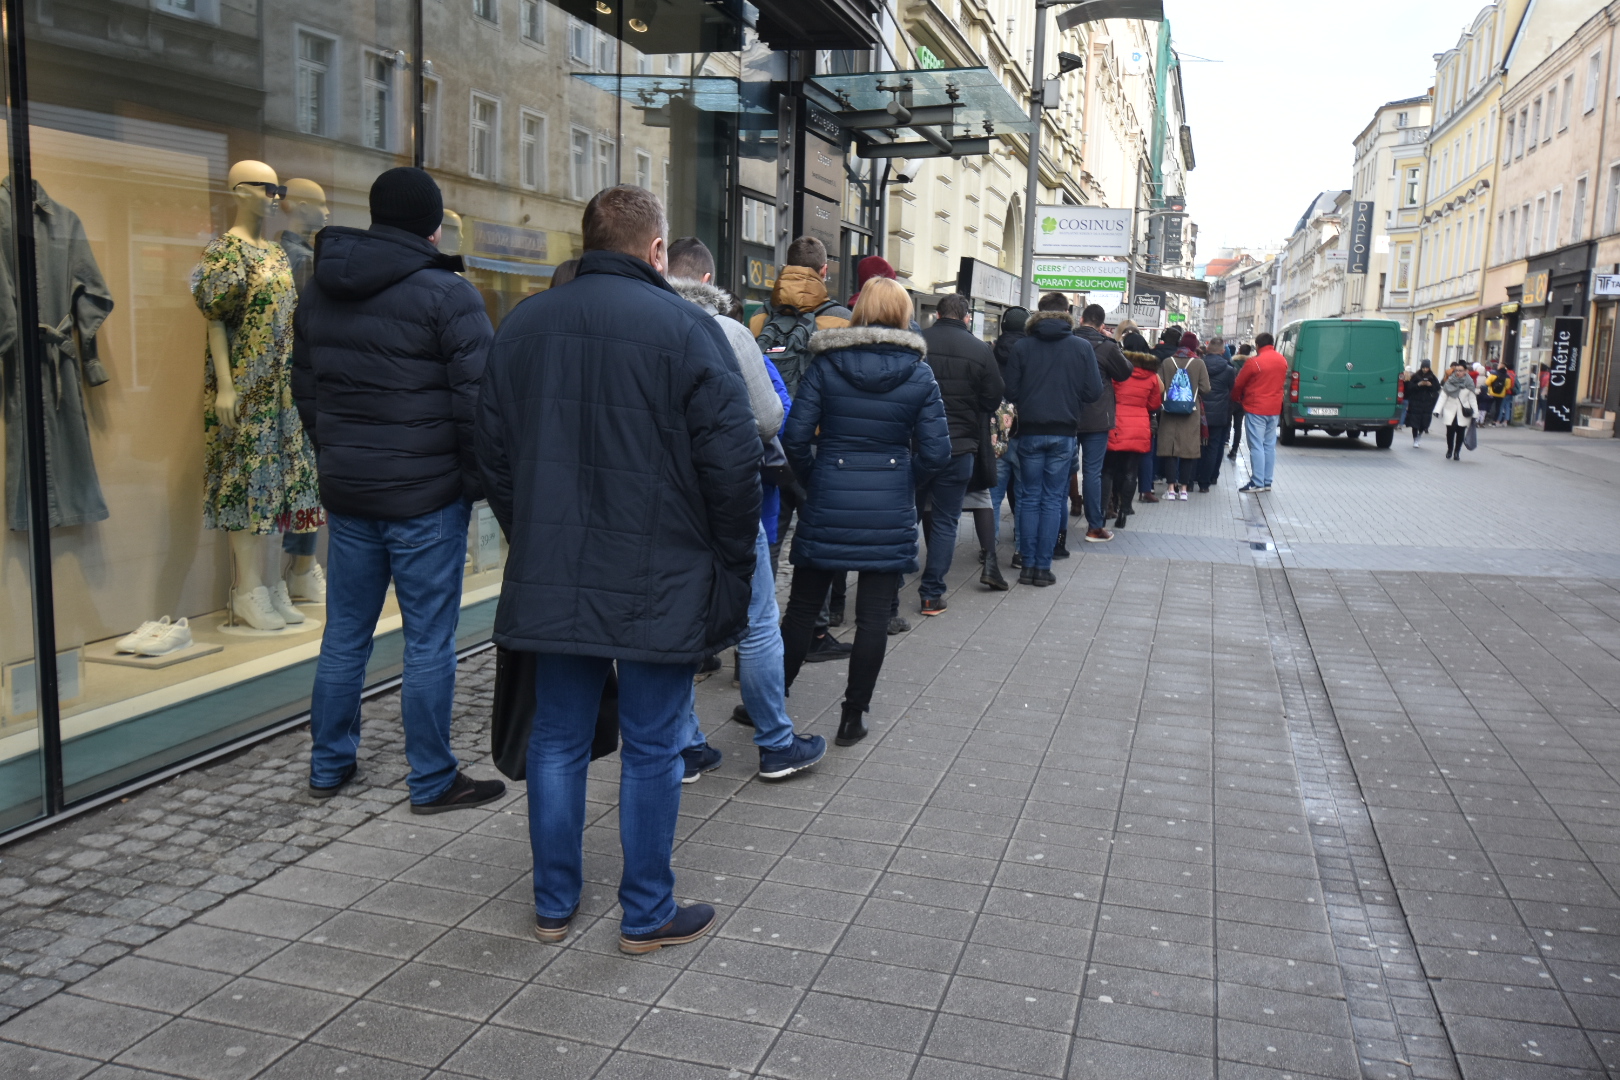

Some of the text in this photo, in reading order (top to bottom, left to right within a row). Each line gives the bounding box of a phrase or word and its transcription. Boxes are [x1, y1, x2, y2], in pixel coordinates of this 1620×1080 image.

[1058, 218, 1124, 231] COSINUS
[1351, 202, 1368, 272] PARFOIS
[1036, 264, 1125, 274] GEERS DOBRY SŁUCH
[1036, 278, 1125, 289] APARATY SŁUCHOWE
[1550, 330, 1571, 387] Chérie
[1568, 346, 1579, 372] Boutique
[295, 507, 329, 531] SKL
